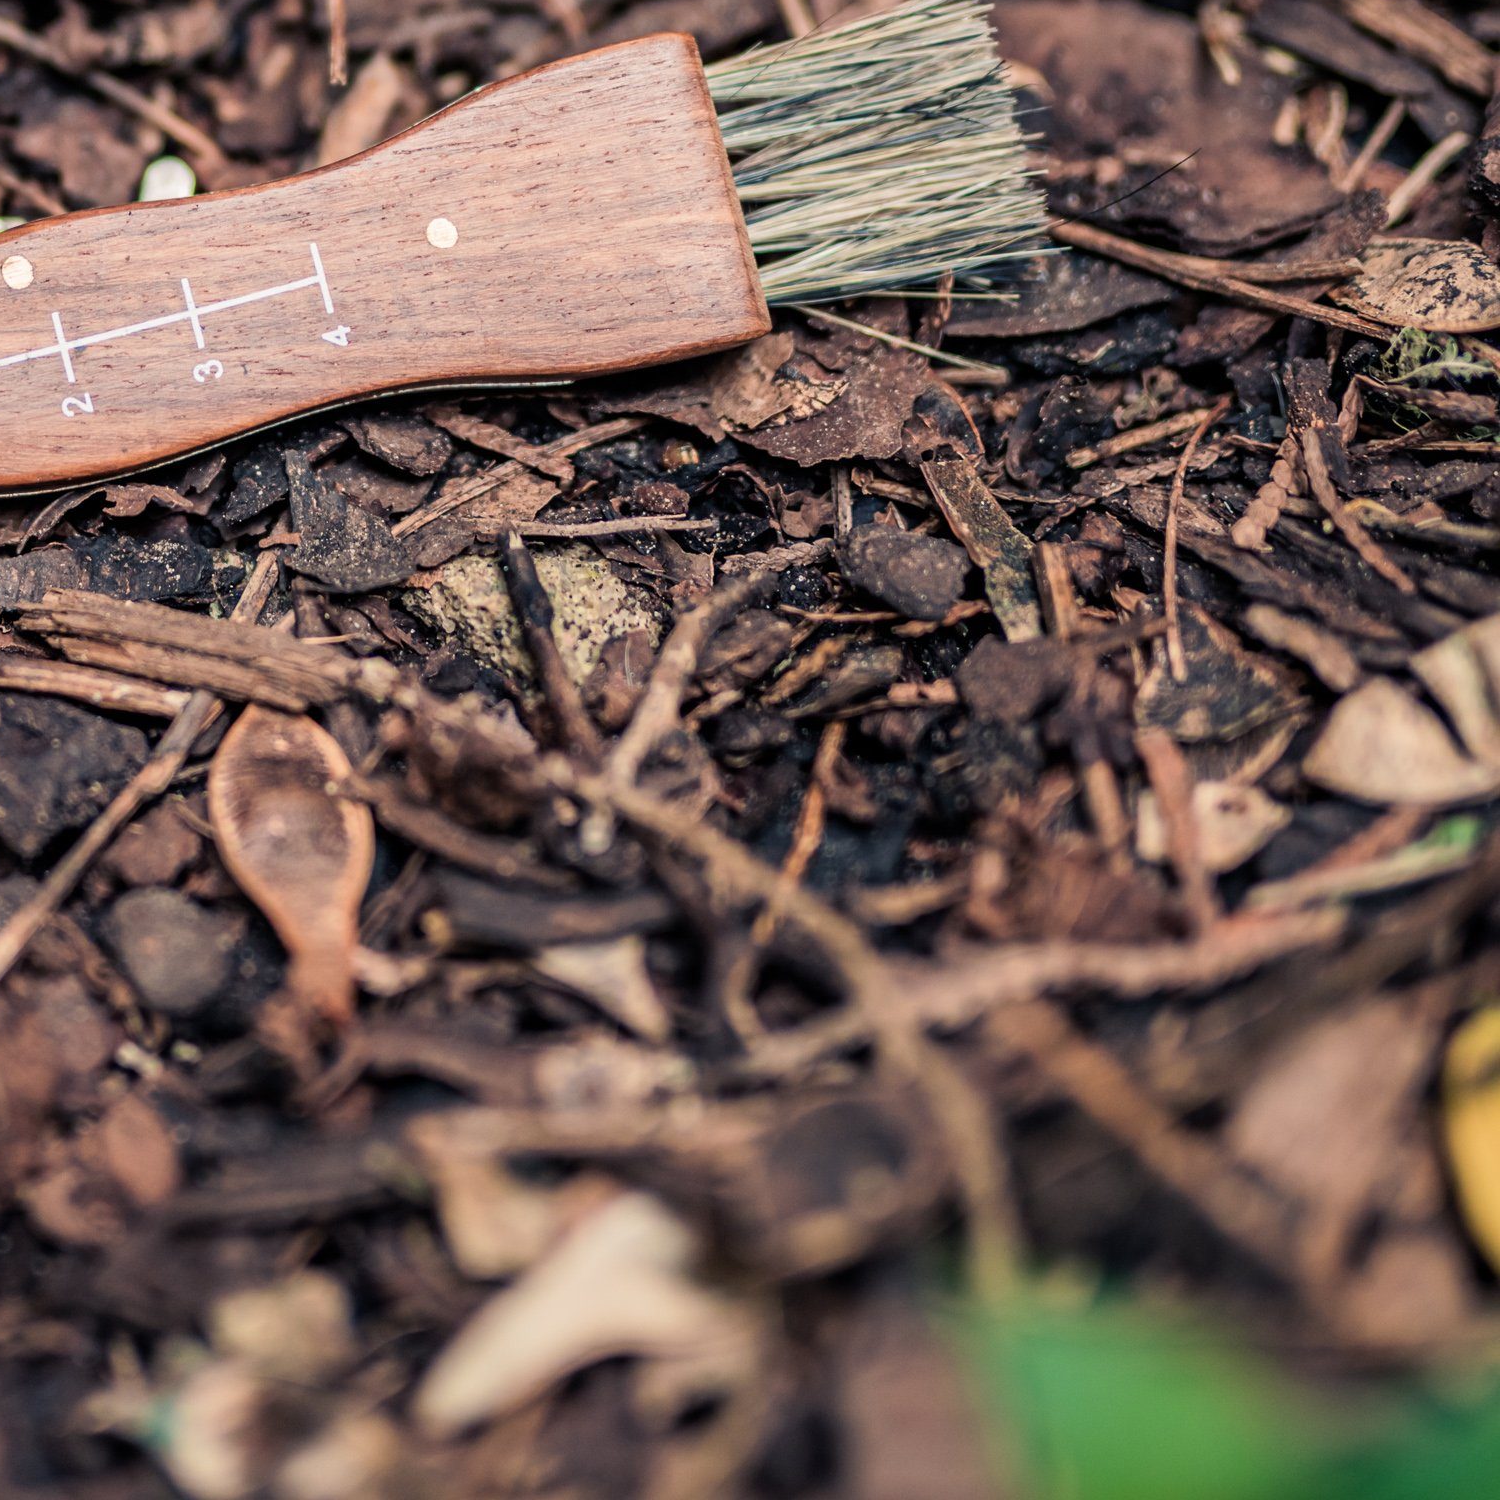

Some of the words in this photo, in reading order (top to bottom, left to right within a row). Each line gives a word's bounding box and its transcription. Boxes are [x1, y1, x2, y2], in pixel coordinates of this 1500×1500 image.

[61, 392, 94, 417] 2
[193, 359, 224, 383] 3
[321, 325, 351, 346] 4
